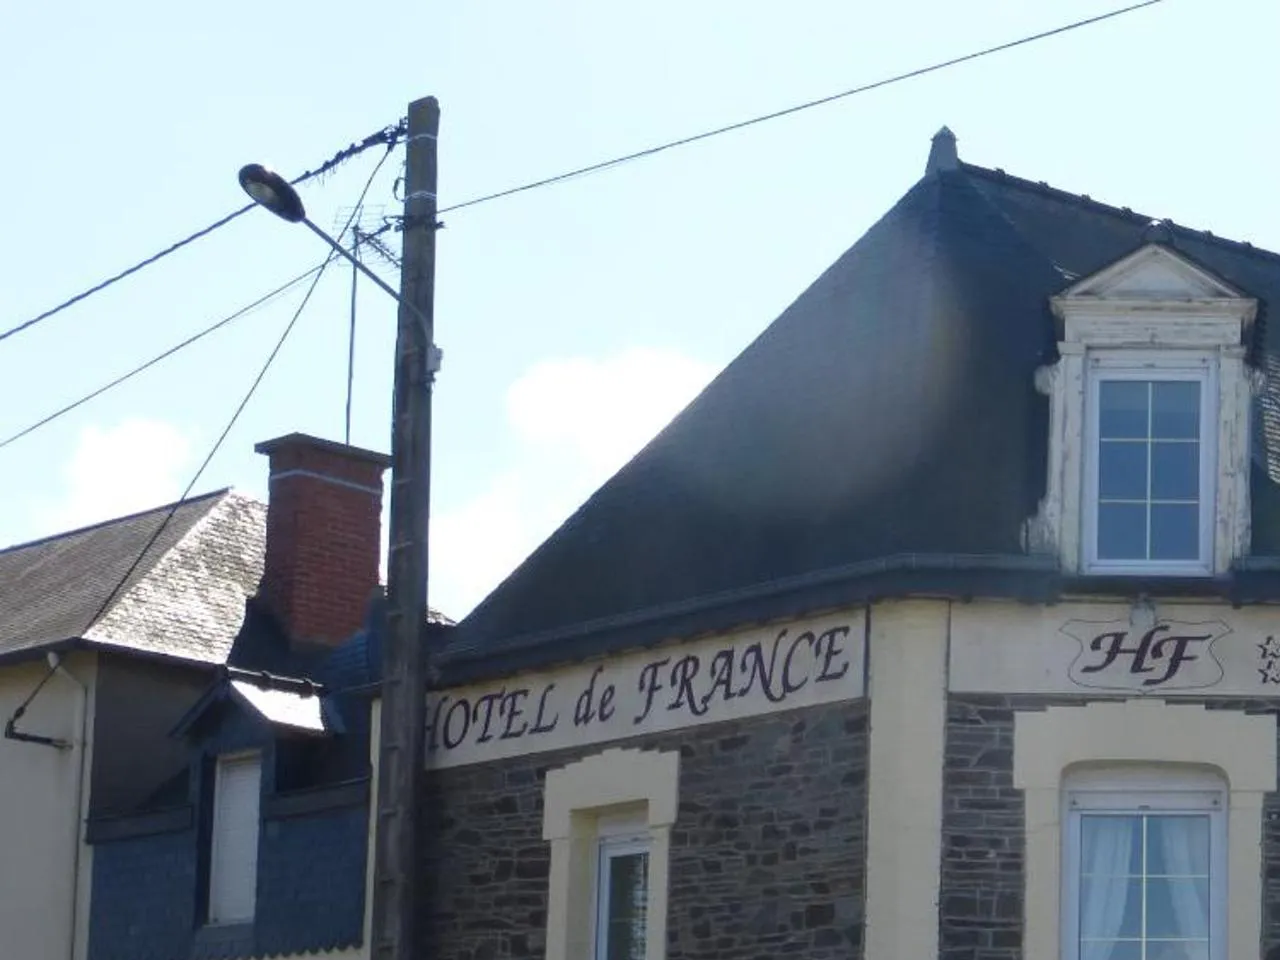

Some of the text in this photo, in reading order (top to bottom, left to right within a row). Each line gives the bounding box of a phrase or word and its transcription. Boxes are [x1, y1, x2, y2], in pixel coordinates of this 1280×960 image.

[573, 664, 617, 727] de
[633, 625, 852, 727] FRANCE
[1081, 624, 1213, 686] HF
